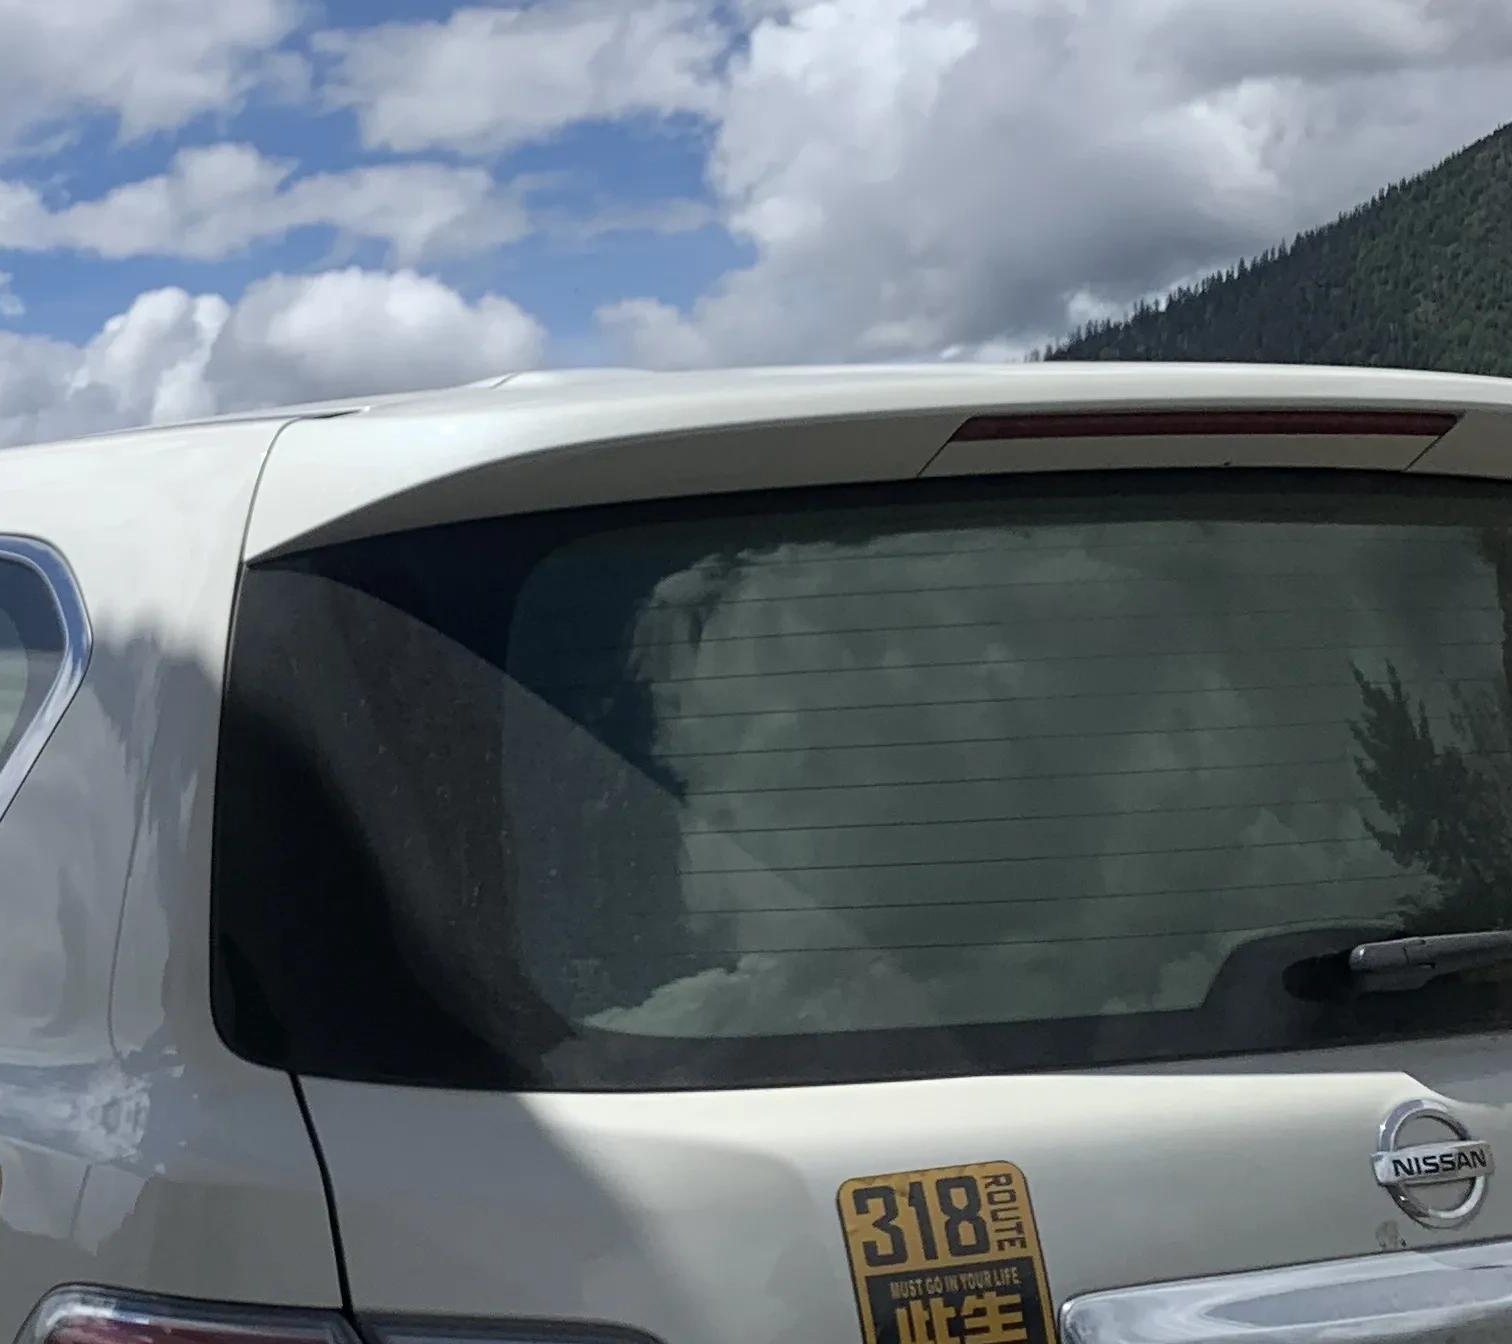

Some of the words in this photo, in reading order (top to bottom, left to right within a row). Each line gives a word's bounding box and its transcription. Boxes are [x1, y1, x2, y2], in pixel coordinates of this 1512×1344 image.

[1391, 1148, 1488, 1177] NISSAN
[852, 1174, 991, 1268] 318
[981, 1173, 1028, 1252] ROUTE
[890, 1278, 923, 1299] MUST
[926, 1276, 944, 1295] GO
[945, 1274, 959, 1294] IN
[959, 1270, 993, 1292] YOUR
[993, 1267, 1022, 1287] LIFE
